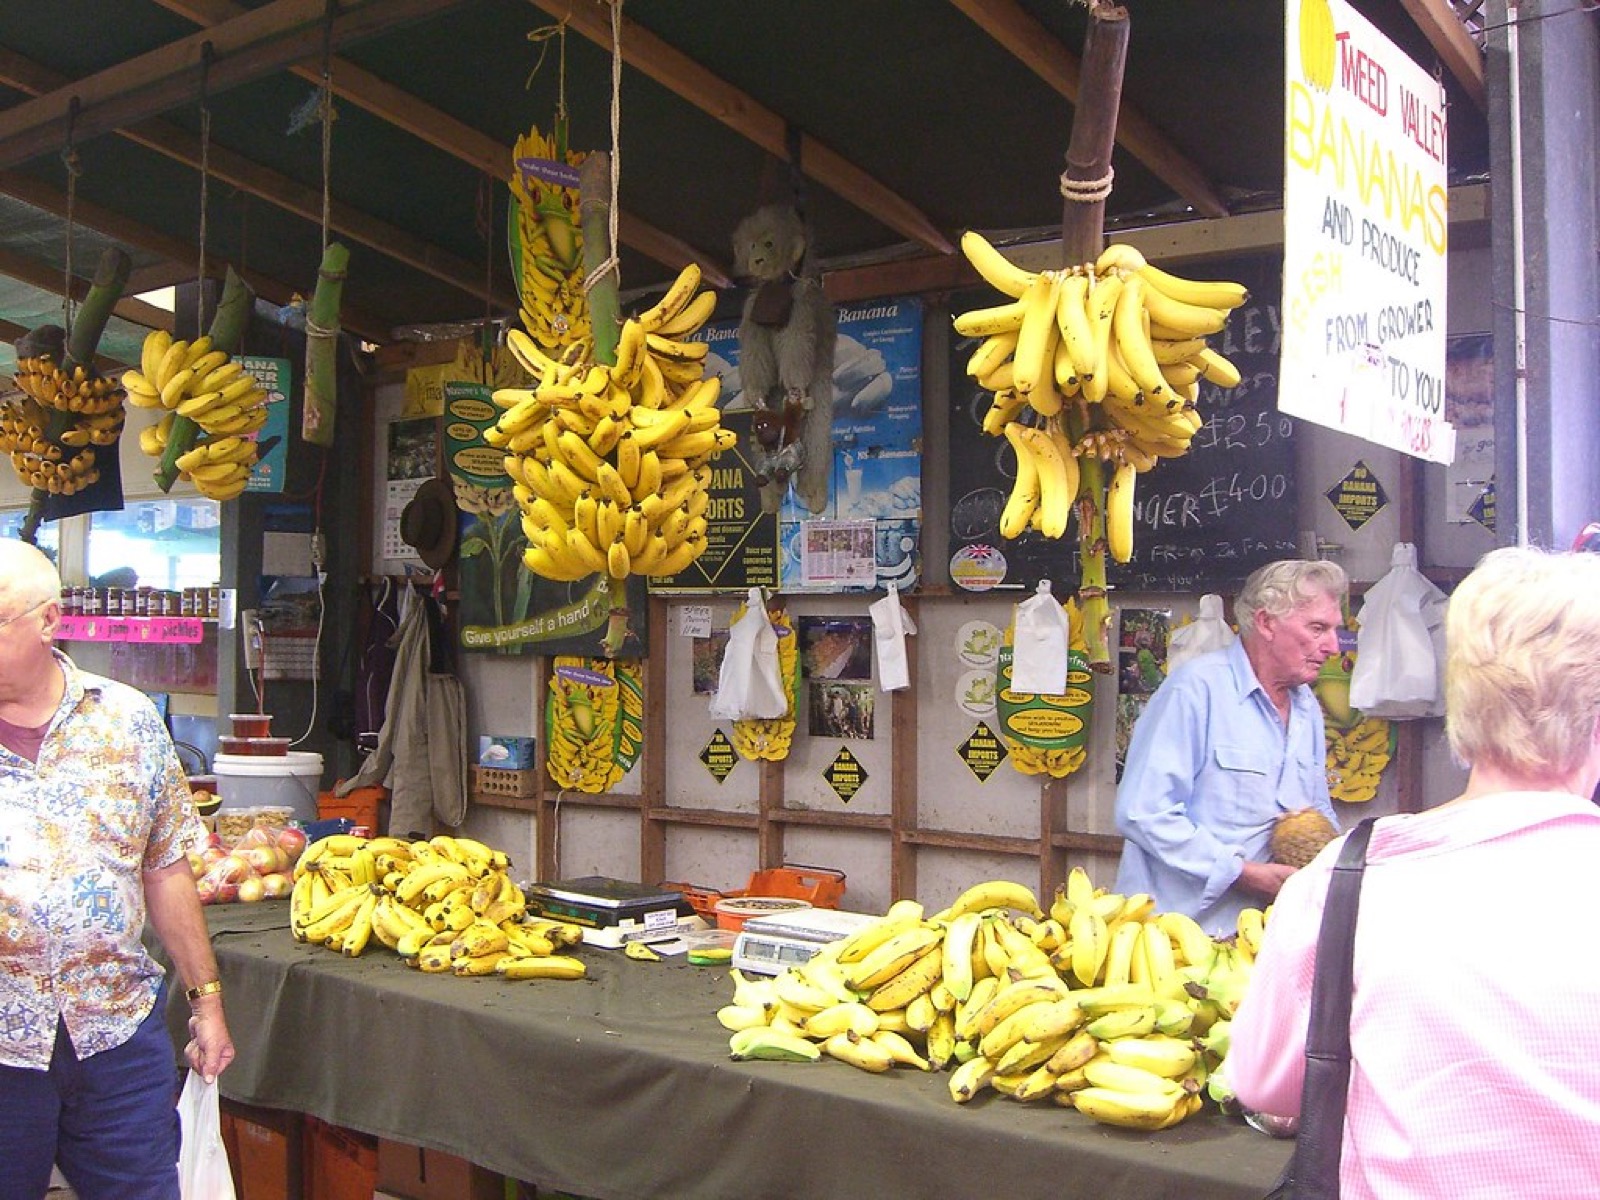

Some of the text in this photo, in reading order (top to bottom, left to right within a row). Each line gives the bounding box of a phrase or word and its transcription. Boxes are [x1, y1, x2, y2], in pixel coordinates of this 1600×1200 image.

[1335, 31, 1448, 166] TWEED VALLEY
[1289, 80, 1448, 257] BANANAS
[1321, 194, 1421, 287] AND PRODUCE
[837, 303, 899, 324] Banana
[1325, 310, 1370, 356] FROM
[1377, 297, 1434, 345] GROWER
[1387, 355, 1410, 401] TO
[1415, 367, 1443, 415] YOU
[711, 468, 745, 490] ANA
[1339, 493, 1377, 506] IMPORTS
[1342, 480, 1376, 492] BANANA
[705, 497, 746, 521] ORTS
[465, 599, 590, 647] Give yourself a hand
